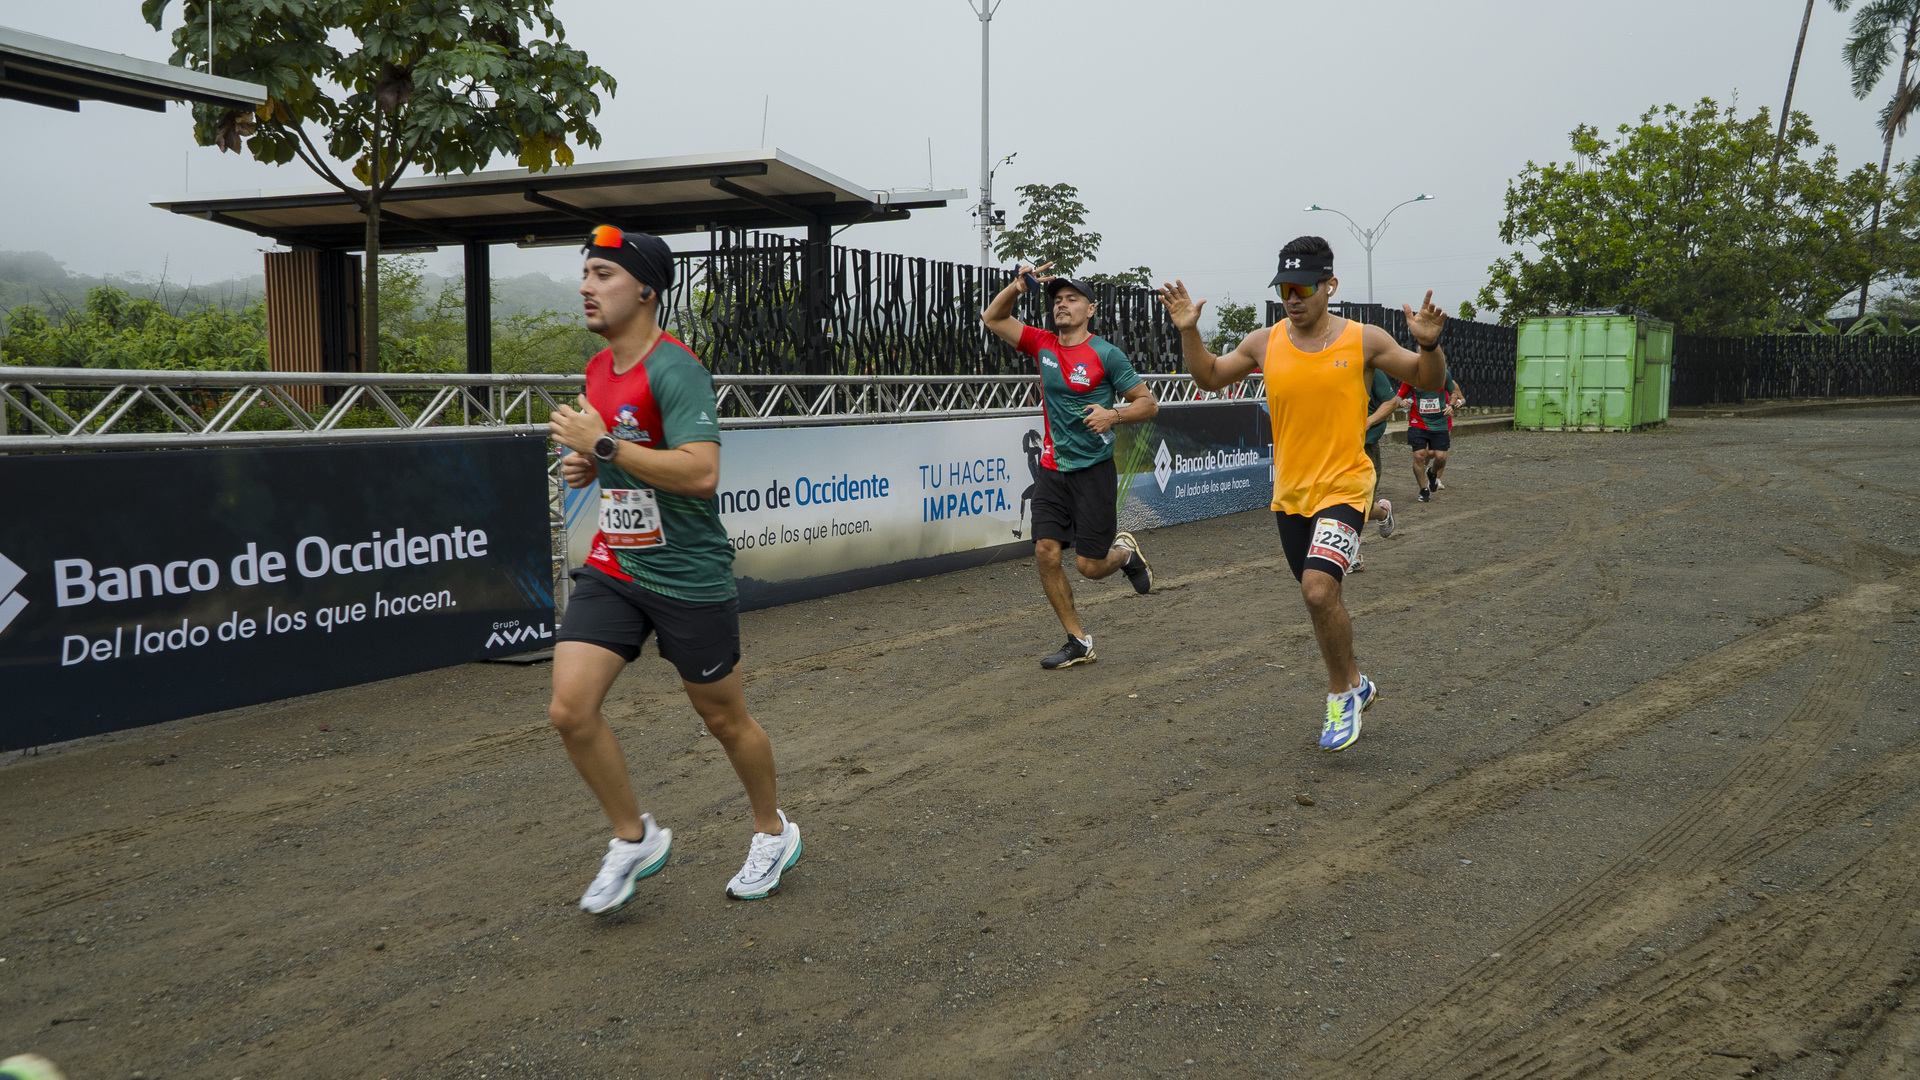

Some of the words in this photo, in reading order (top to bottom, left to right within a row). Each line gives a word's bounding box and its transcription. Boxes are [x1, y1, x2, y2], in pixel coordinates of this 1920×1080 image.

[918, 464, 942, 489] TU
[950, 458, 1010, 486] HACER,
[1175, 453, 1202, 474] Banco
[1205, 451, 1216, 470] de
[1217, 448, 1258, 469] Occidente
[765, 479, 790, 510] de
[795, 474, 889, 506] Occidente
[1175, 484, 1186, 498] Del
[1202, 480, 1209, 494] de
[1210, 479, 1219, 492] los
[1220, 481, 1231, 493] que
[1231, 477, 1250, 490] hacen.
[606, 507, 646, 529] 1302
[923, 488, 1011, 522] IMPACTA.
[727, 529, 755, 550] ado
[759, 527, 776, 547] de
[780, 523, 799, 543] los
[803, 523, 827, 545] que
[831, 518, 872, 537] hacen.
[54, 557, 220, 608] Banco
[230, 541, 287, 587] de
[296, 525, 488, 578] Occidente
[61, 626, 122, 667] Del
[134, 618, 210, 656] lado
[217, 611, 257, 642] de
[266, 606, 307, 635] los
[315, 602, 366, 633] que
[374, 589, 457, 618] hacen.
[484, 622, 552, 649] AVAL
[492, 619, 520, 630] Grupo
